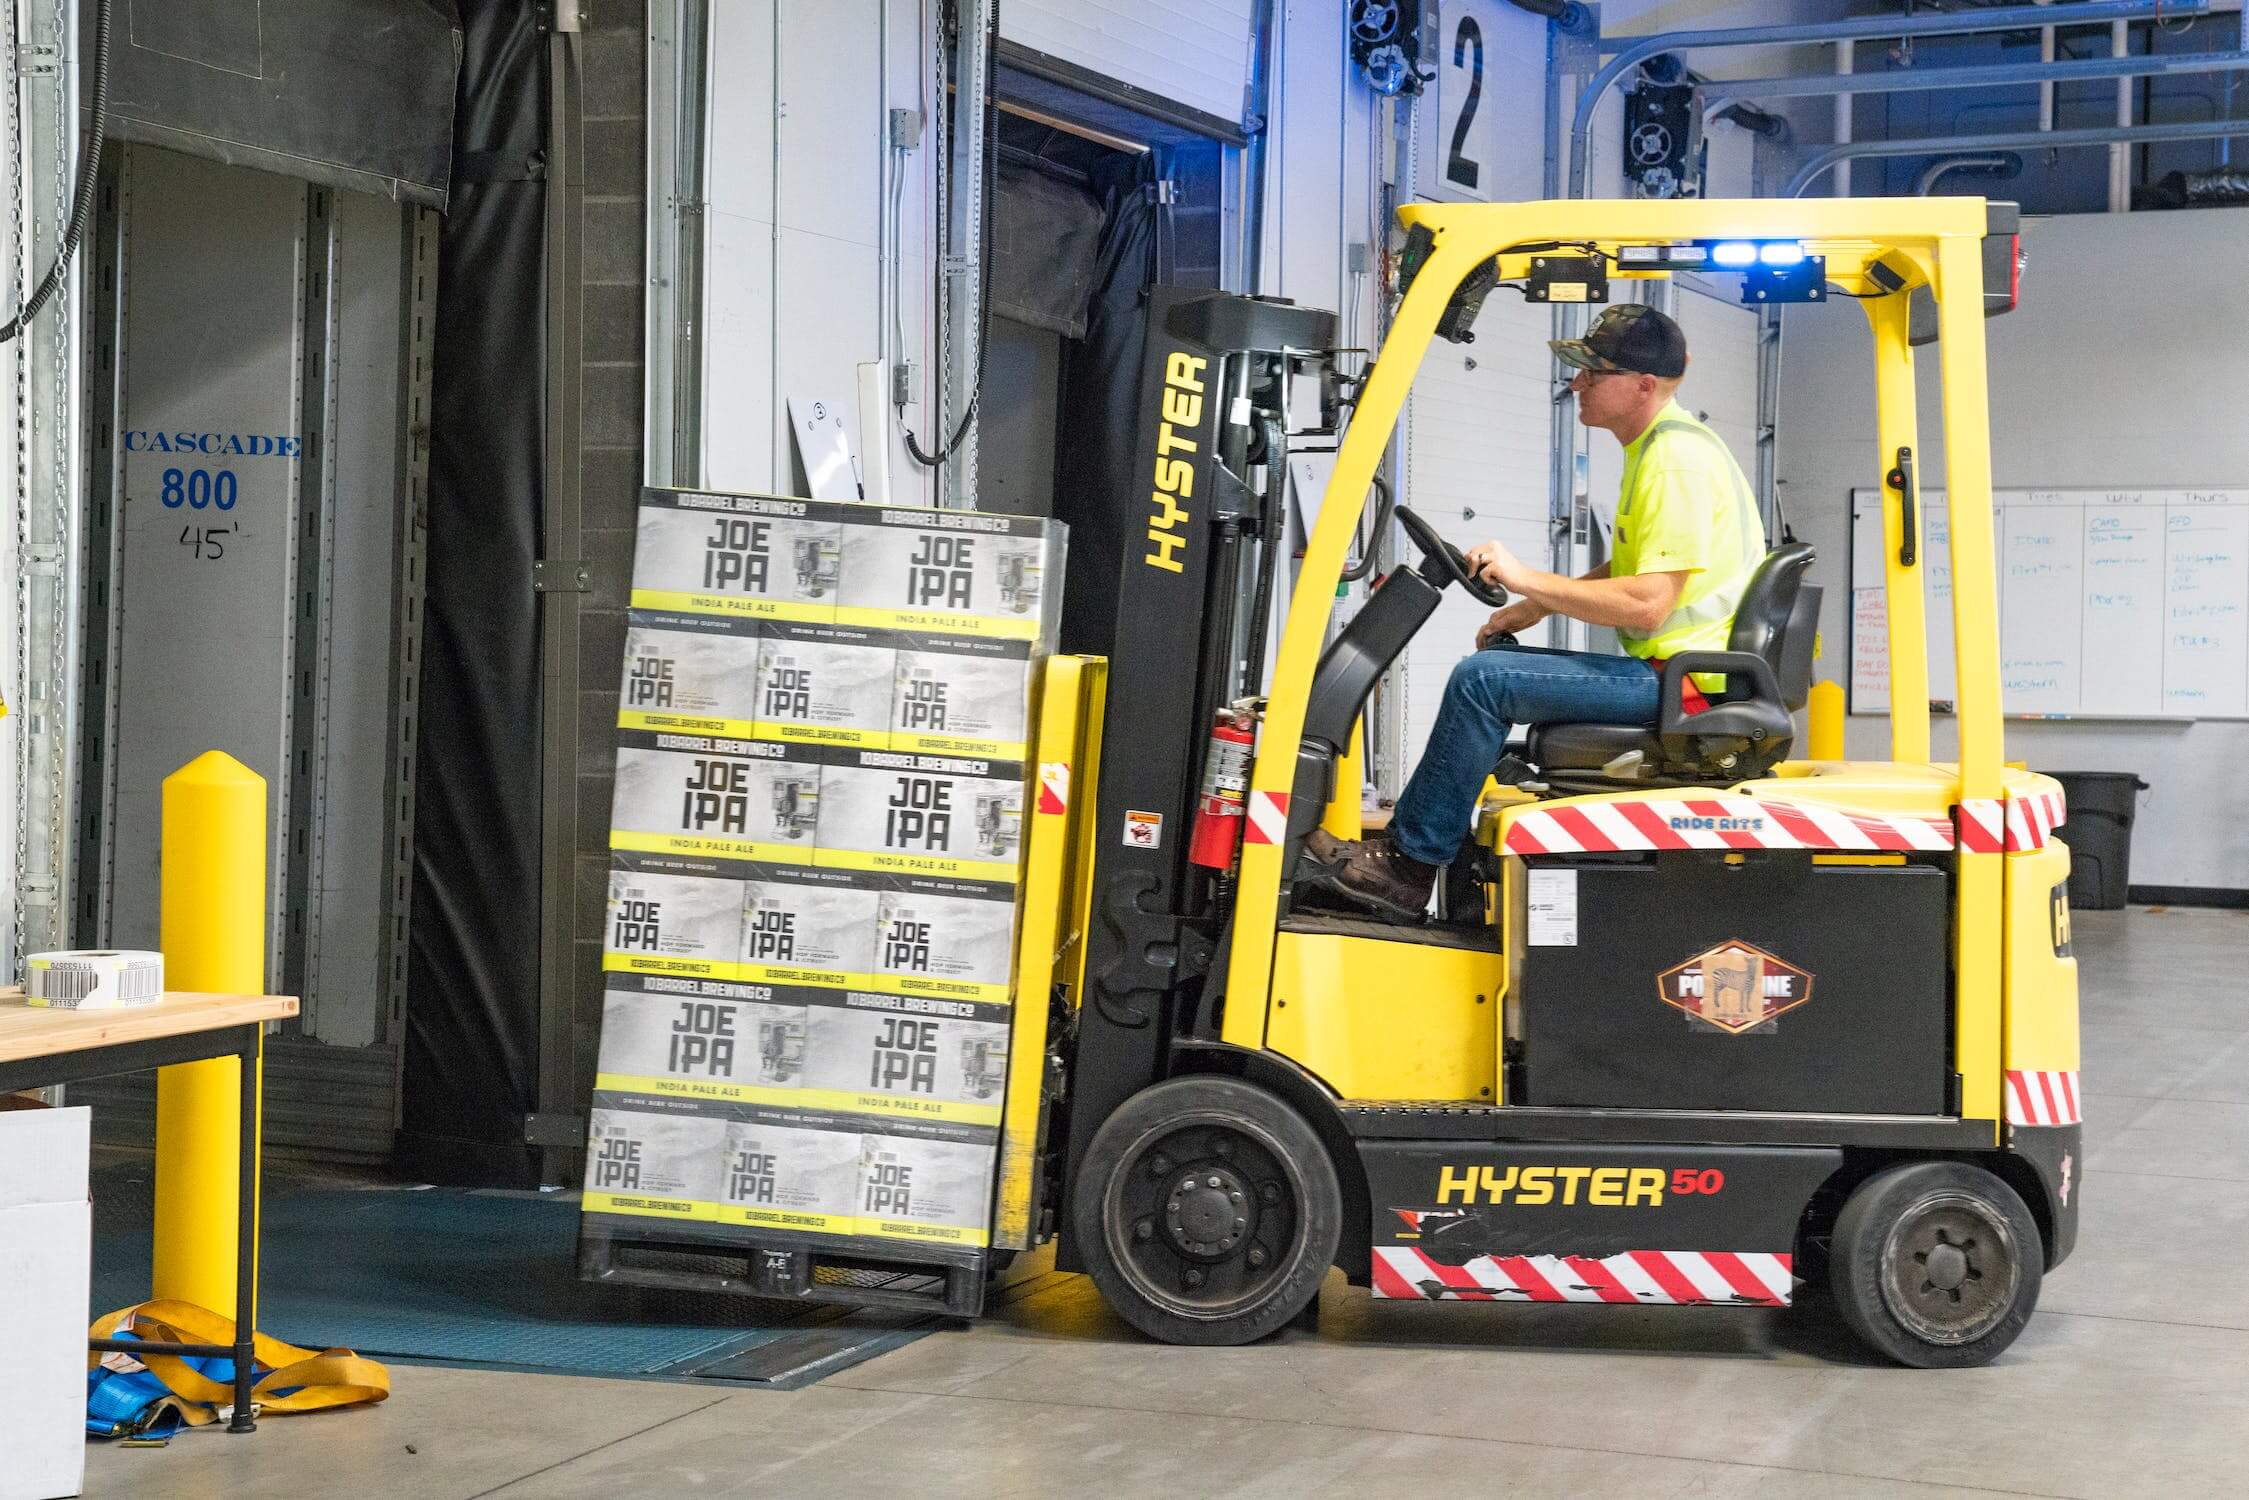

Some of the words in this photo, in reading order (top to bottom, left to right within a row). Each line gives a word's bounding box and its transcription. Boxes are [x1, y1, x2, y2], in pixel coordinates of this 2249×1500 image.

[1447, 16, 1483, 189] 2
[125, 430, 301, 458] CASCADE
[1145, 352, 1207, 574] HYSTER
[161, 468, 237, 510] 800
[2185, 493, 2228, 503] Thurs
[706, 518, 771, 552] JOE
[910, 534, 975, 568] JOE
[703, 550, 768, 592] IPA
[907, 566, 972, 609] IPA
[691, 597, 723, 608] INDIA
[727, 600, 752, 610] PALE
[756, 602, 775, 612] ALE
[631, 656, 674, 680] JOE
[767, 667, 810, 691] JOE
[628, 679, 672, 707] IPA
[765, 690, 809, 718] IPA
[904, 679, 947, 703] JOE
[902, 702, 946, 730] IPA
[685, 759, 750, 793] JOE
[888, 776, 953, 810] JOE
[682, 791, 747, 833] IPA
[1671, 817, 1714, 830] RIDE
[885, 809, 950, 851] IPA
[669, 838, 701, 849] INDIA
[706, 841, 731, 851] PALE
[734, 843, 754, 853] ALE
[872, 856, 904, 866] INDIA
[909, 859, 934, 869] PALE
[937, 861, 957, 871] ALE
[616, 899, 660, 923] JOE
[751, 909, 795, 933] JOE
[614, 922, 658, 950] IPA
[749, 932, 793, 960] IPA
[887, 920, 930, 944] JOE
[885, 942, 928, 971] IPA
[671, 1001, 736, 1036] JOE
[873, 1017, 938, 1052] JOE
[668, 1034, 733, 1076] IPA
[870, 1050, 935, 1092] IPA
[655, 1081, 687, 1092] INDIA
[692, 1084, 717, 1094] PALE
[720, 1086, 740, 1096] ALE
[857, 1097, 889, 1108] INDIA
[894, 1100, 919, 1110] PALE
[922, 1102, 942, 1112] ALE
[598, 1138, 641, 1162] JOE
[732, 1151, 776, 1175] JOE
[595, 1160, 639, 1189] IPA
[730, 1174, 774, 1202] IPA
[868, 1163, 911, 1187] JOE
[1436, 1166, 1667, 1206] HYSTER
[1671, 1168, 1725, 1195] 50
[865, 1186, 909, 1214] IPA
